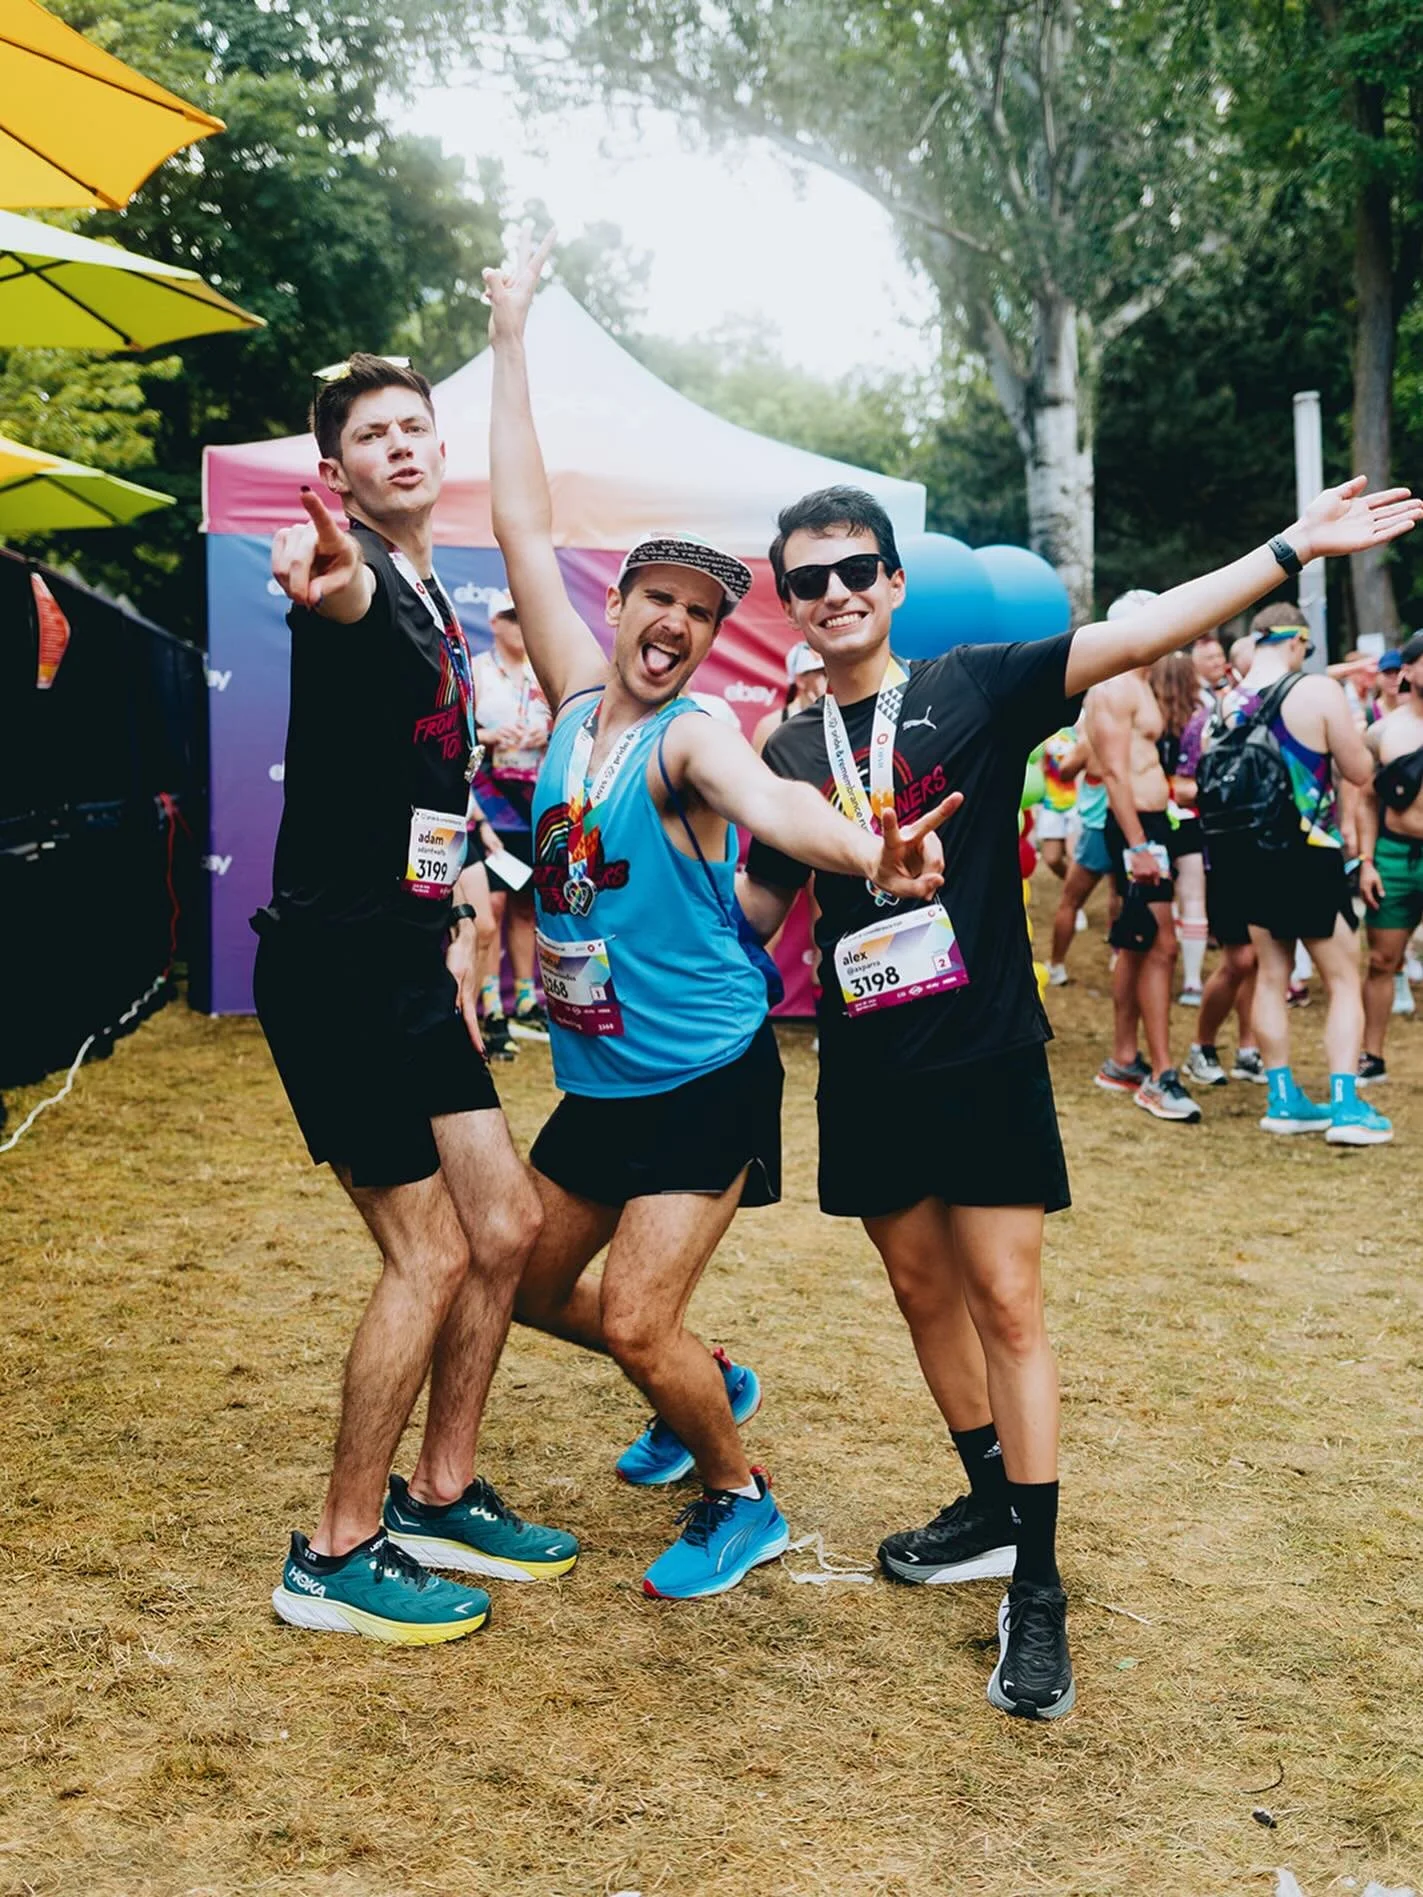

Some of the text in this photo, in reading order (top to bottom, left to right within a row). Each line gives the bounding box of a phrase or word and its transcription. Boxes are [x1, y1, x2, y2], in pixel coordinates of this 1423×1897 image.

[724, 681, 778, 707] ebay
[418, 830, 444, 846] adam
[416, 858, 448, 882] 3199
[842, 951, 868, 967] alex
[938, 958, 946, 968] 2
[850, 966, 900, 998] 3198
[288, 1565, 327, 1599] HOKA
